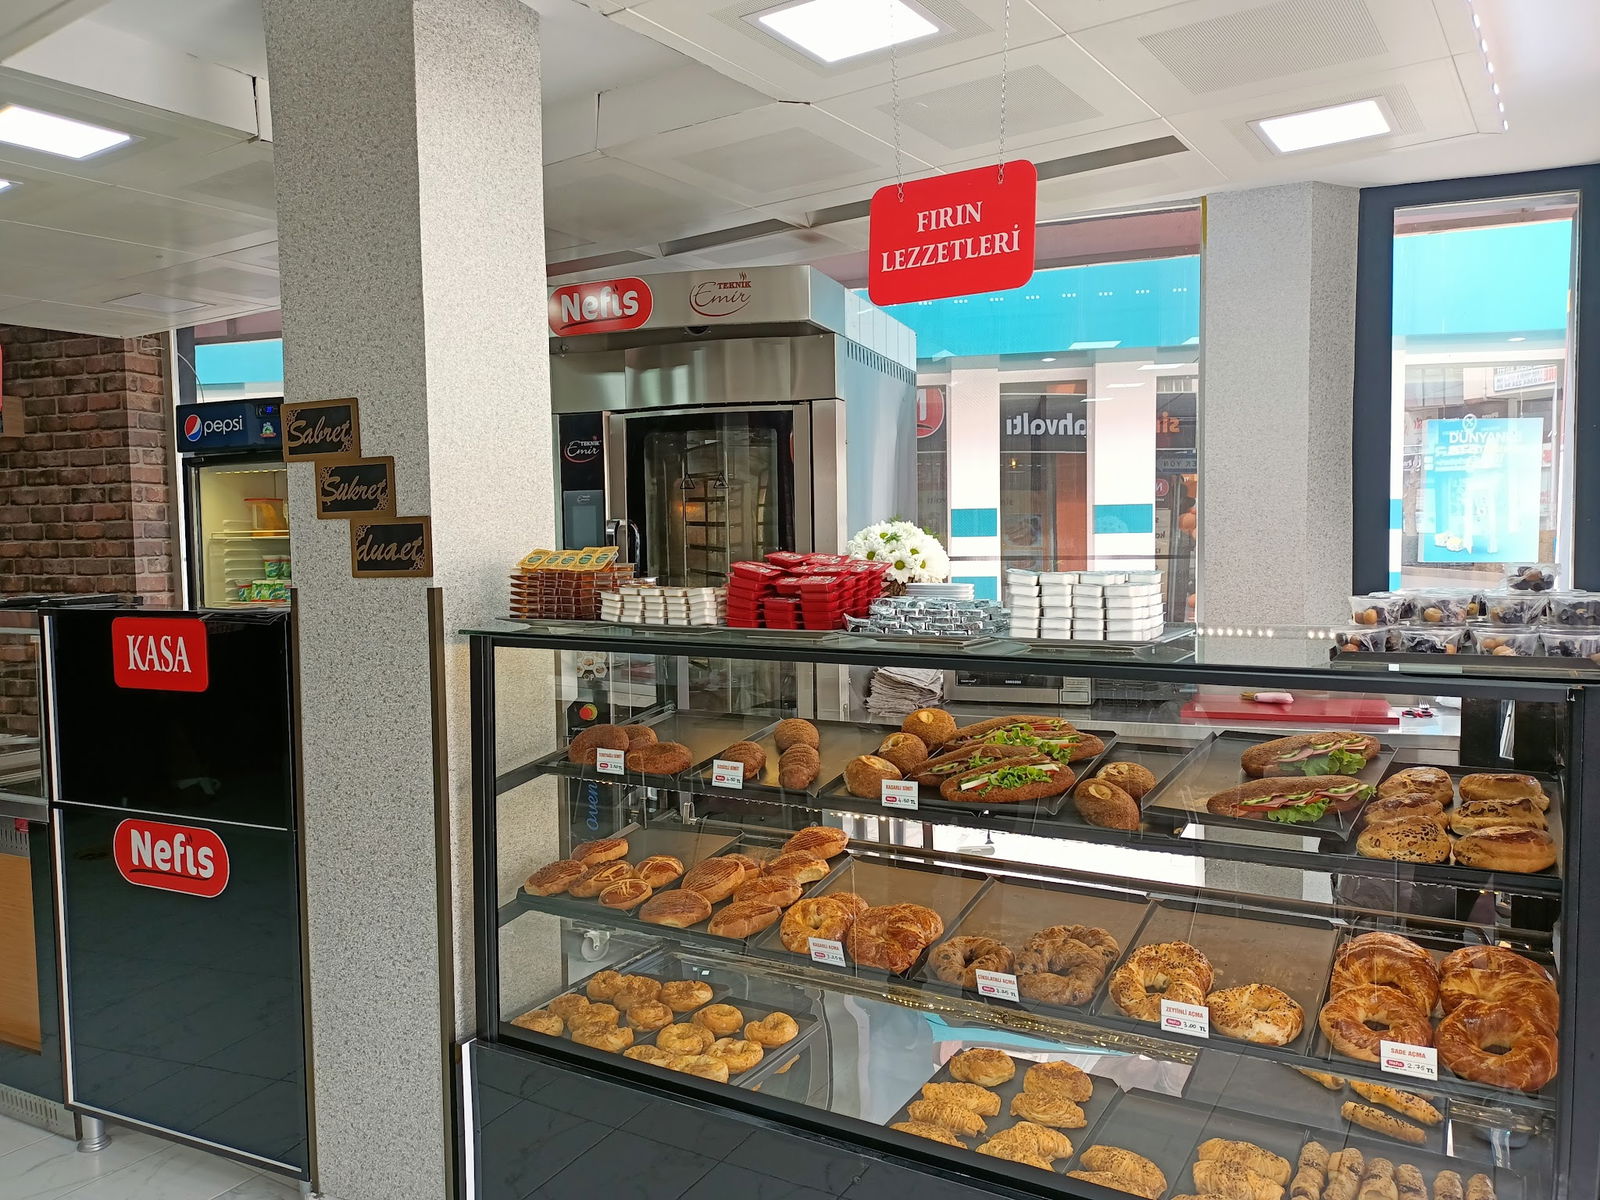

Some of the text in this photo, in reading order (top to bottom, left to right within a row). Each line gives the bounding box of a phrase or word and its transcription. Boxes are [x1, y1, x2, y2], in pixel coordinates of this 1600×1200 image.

[916, 201, 983, 232] FIRIN
[881, 223, 1021, 272] LEZZETLERİ
[561, 286, 639, 323] Nefis
[693, 281, 752, 307] Emir
[204, 415, 243, 436] pepsi
[288, 416, 350, 447] Sabret
[567, 440, 600, 457] Emir
[357, 534, 422, 561] dua et
[126, 634, 192, 674] KASA
[130, 829, 215, 880] Nefis
[1199, 1025, 1206, 1033] TL
[1390, 1047, 1426, 1059] SADE AÇMA
